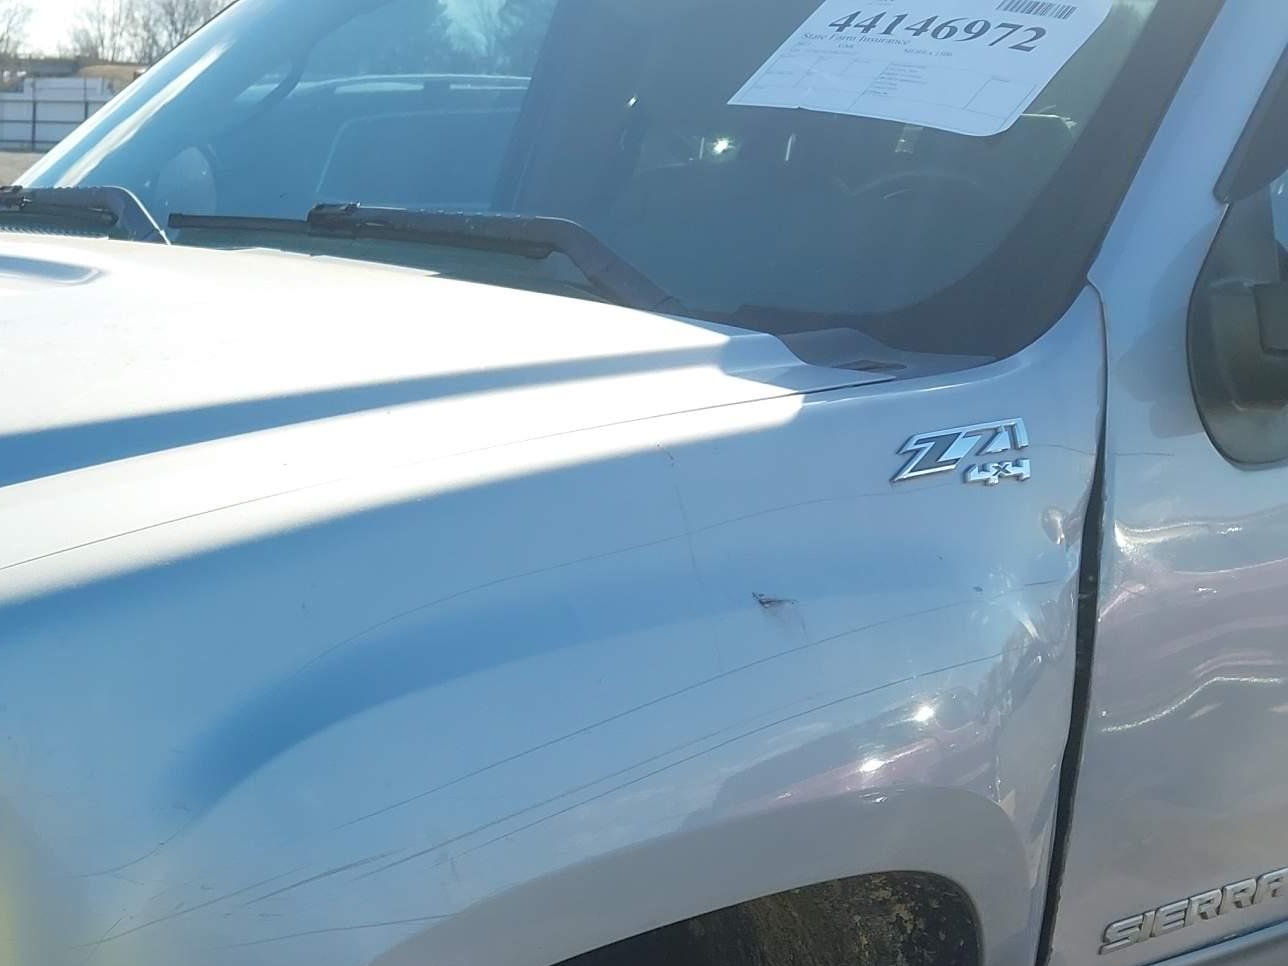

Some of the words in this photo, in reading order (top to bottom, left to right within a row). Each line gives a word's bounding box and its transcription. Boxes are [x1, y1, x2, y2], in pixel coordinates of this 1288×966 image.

[802, 32, 828, 41] State
[829, 33, 856, 43] Farm
[857, 35, 912, 46] Insurance
[828, 10, 1047, 52] 44146972
[890, 417, 1030, 482] Z71
